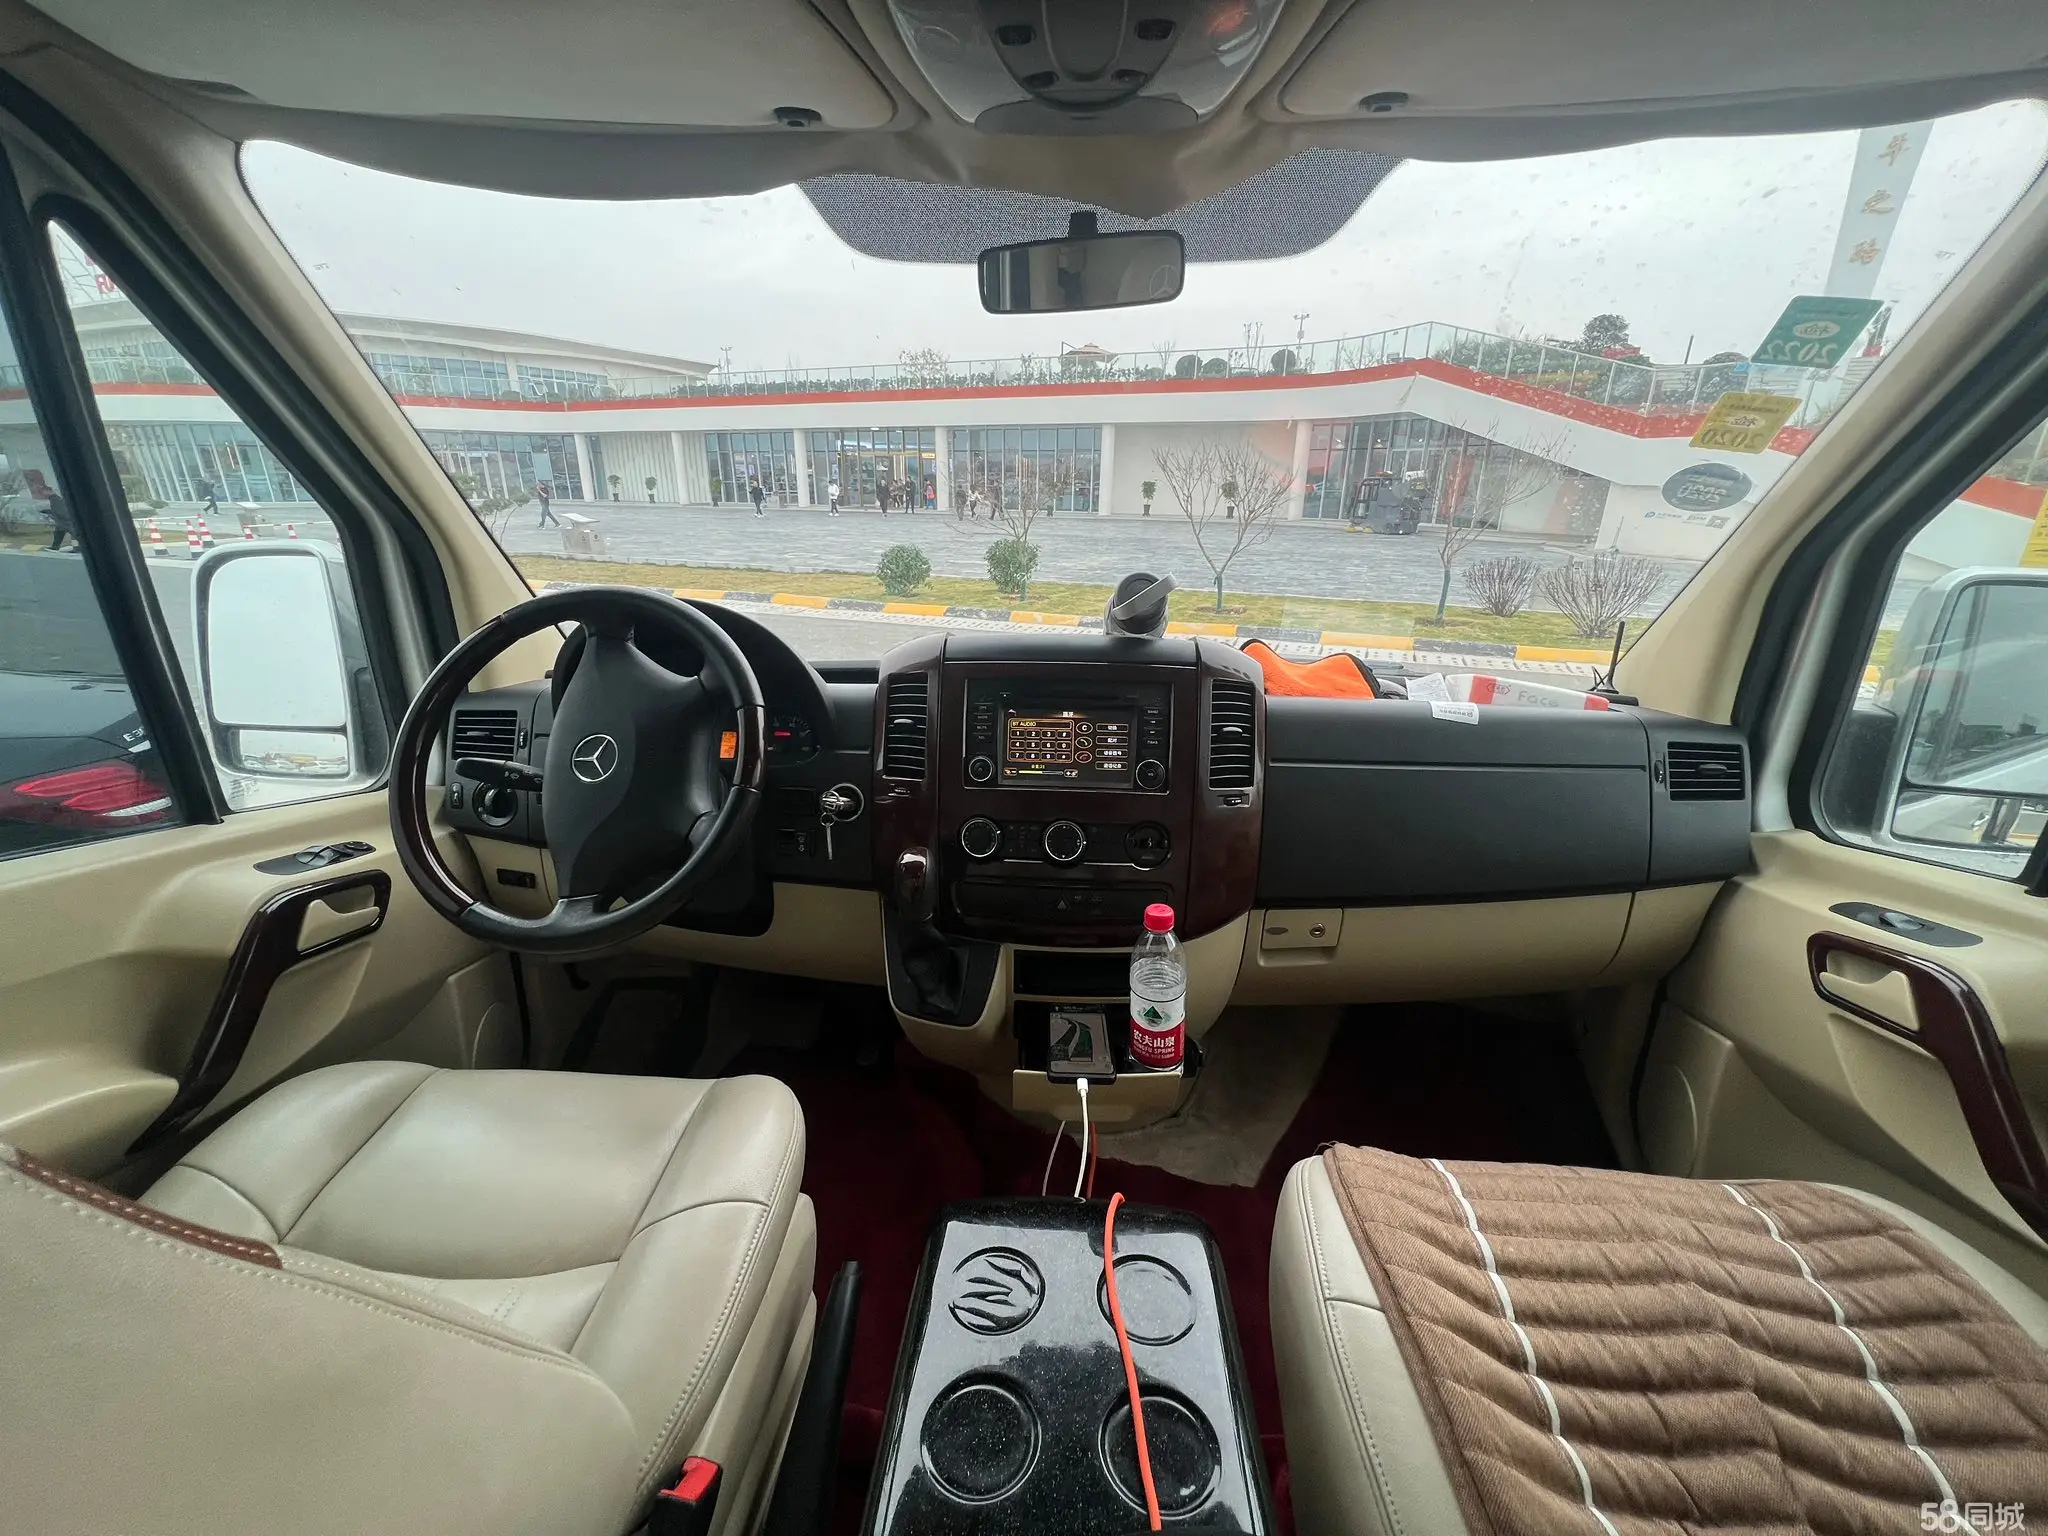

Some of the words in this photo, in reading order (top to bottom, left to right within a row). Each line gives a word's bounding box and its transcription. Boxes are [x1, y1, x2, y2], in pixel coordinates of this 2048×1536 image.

[1518, 690, 1560, 708] Face
[1133, 1029, 1175, 1048] 农夫山泉
